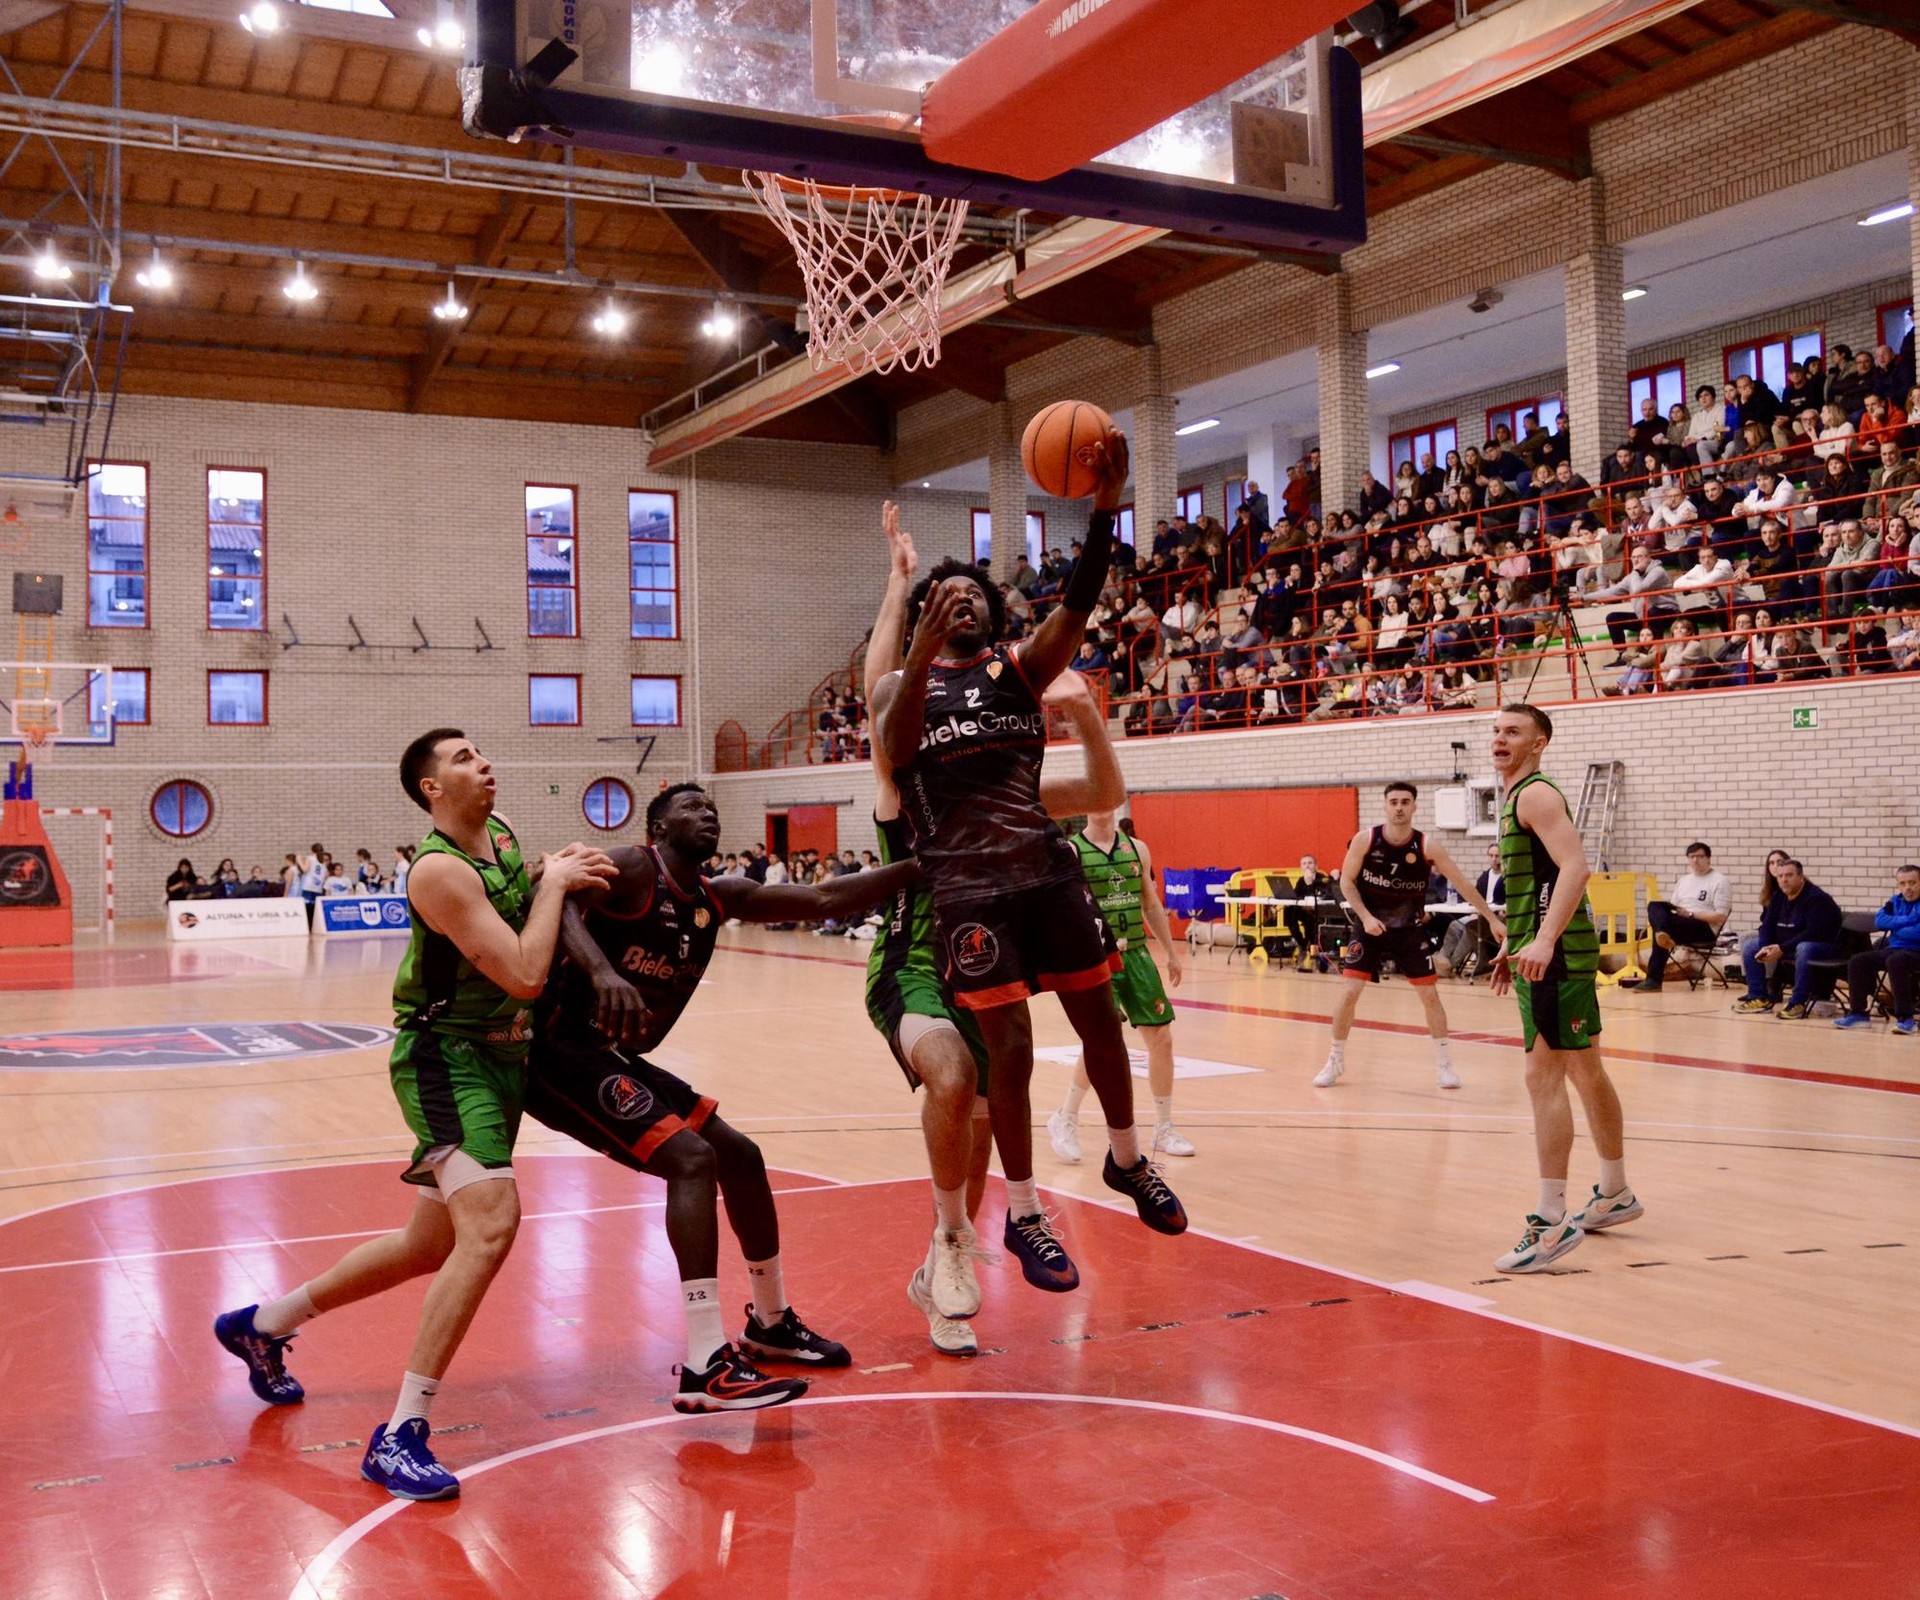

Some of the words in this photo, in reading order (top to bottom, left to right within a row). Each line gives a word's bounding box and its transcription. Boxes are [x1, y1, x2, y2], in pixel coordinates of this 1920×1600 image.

[1061, 0, 1112, 33] MON
[964, 687, 983, 708] 2
[1362, 868, 1426, 891] BieleGroup
[1390, 863, 1399, 875] 7
[686, 1290, 707, 1301] 23
